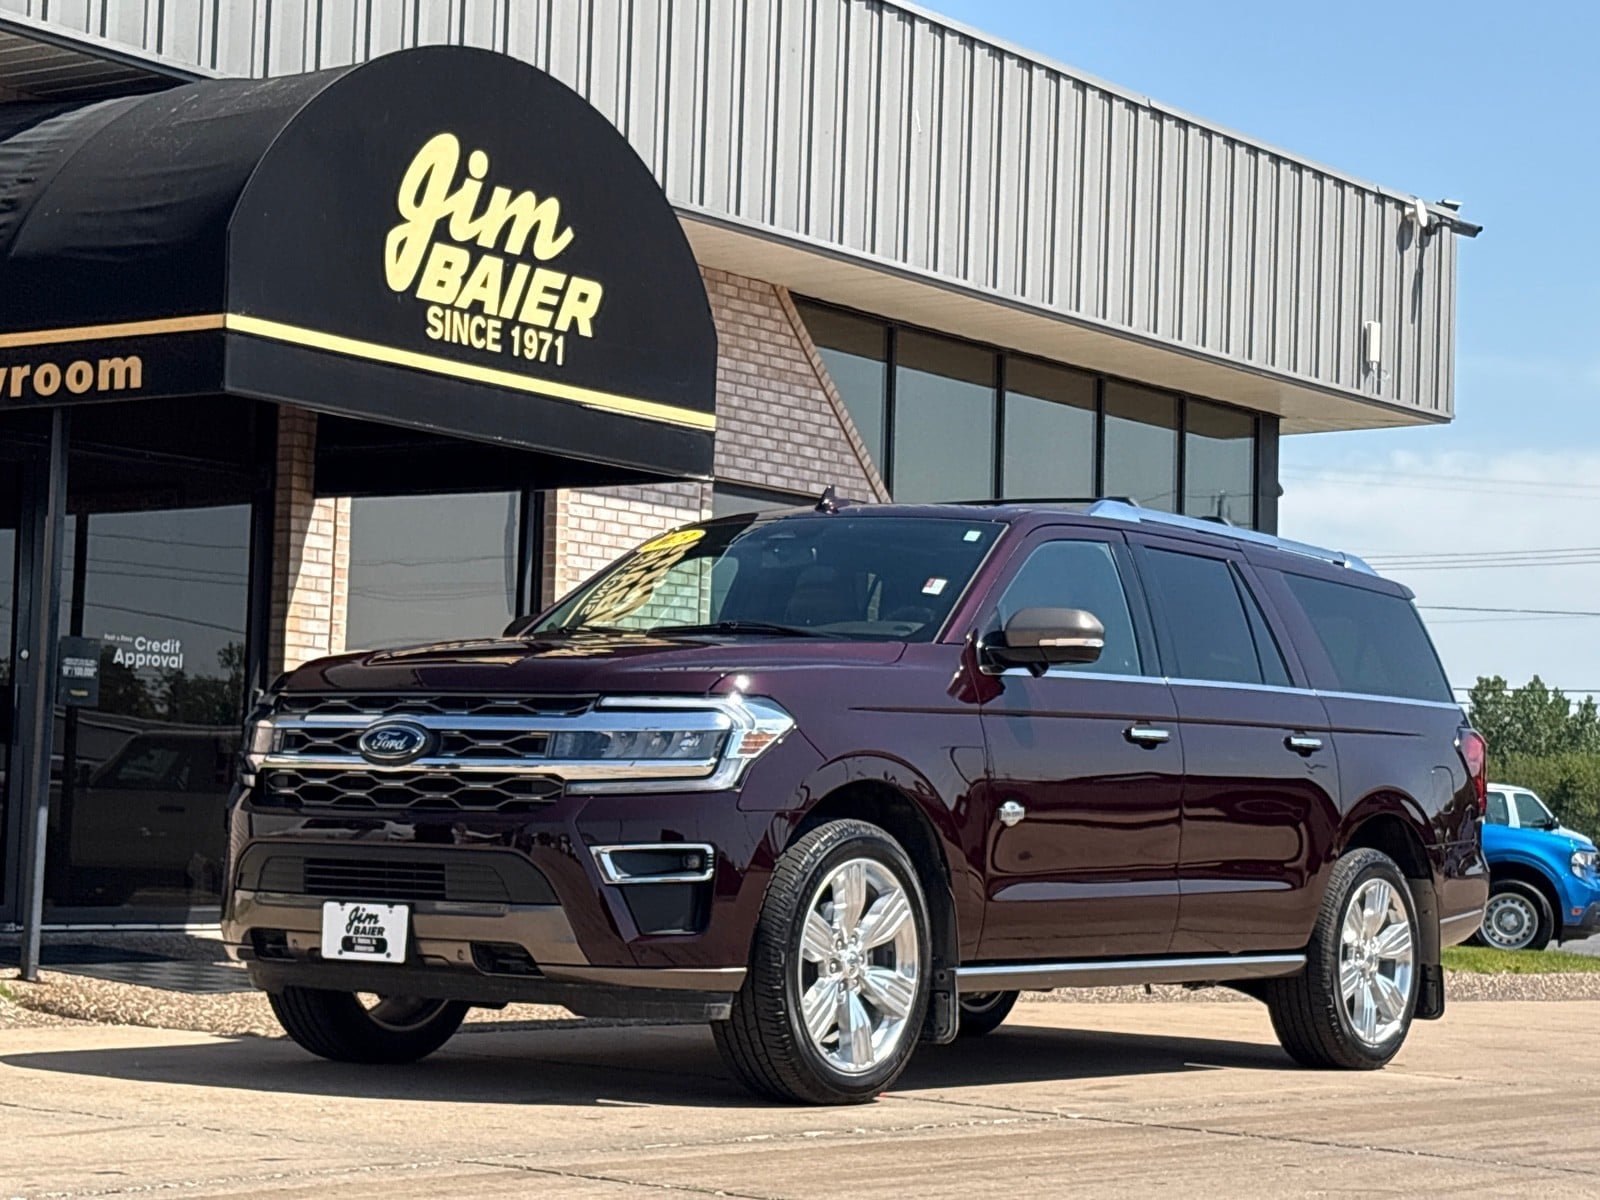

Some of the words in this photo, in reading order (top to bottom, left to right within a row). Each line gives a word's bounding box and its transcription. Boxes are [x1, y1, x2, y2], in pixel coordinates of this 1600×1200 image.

[384, 132, 574, 292] Jim
[415, 242, 603, 338] BAIER
[425, 305, 503, 353] SINCE
[511, 325, 565, 366] 1971
[134, 636, 181, 654] Credit
[113, 648, 183, 668] Approval
[371, 731, 408, 750] Ford
[346, 906, 379, 933] Jim
[353, 925, 386, 936] BAIER
